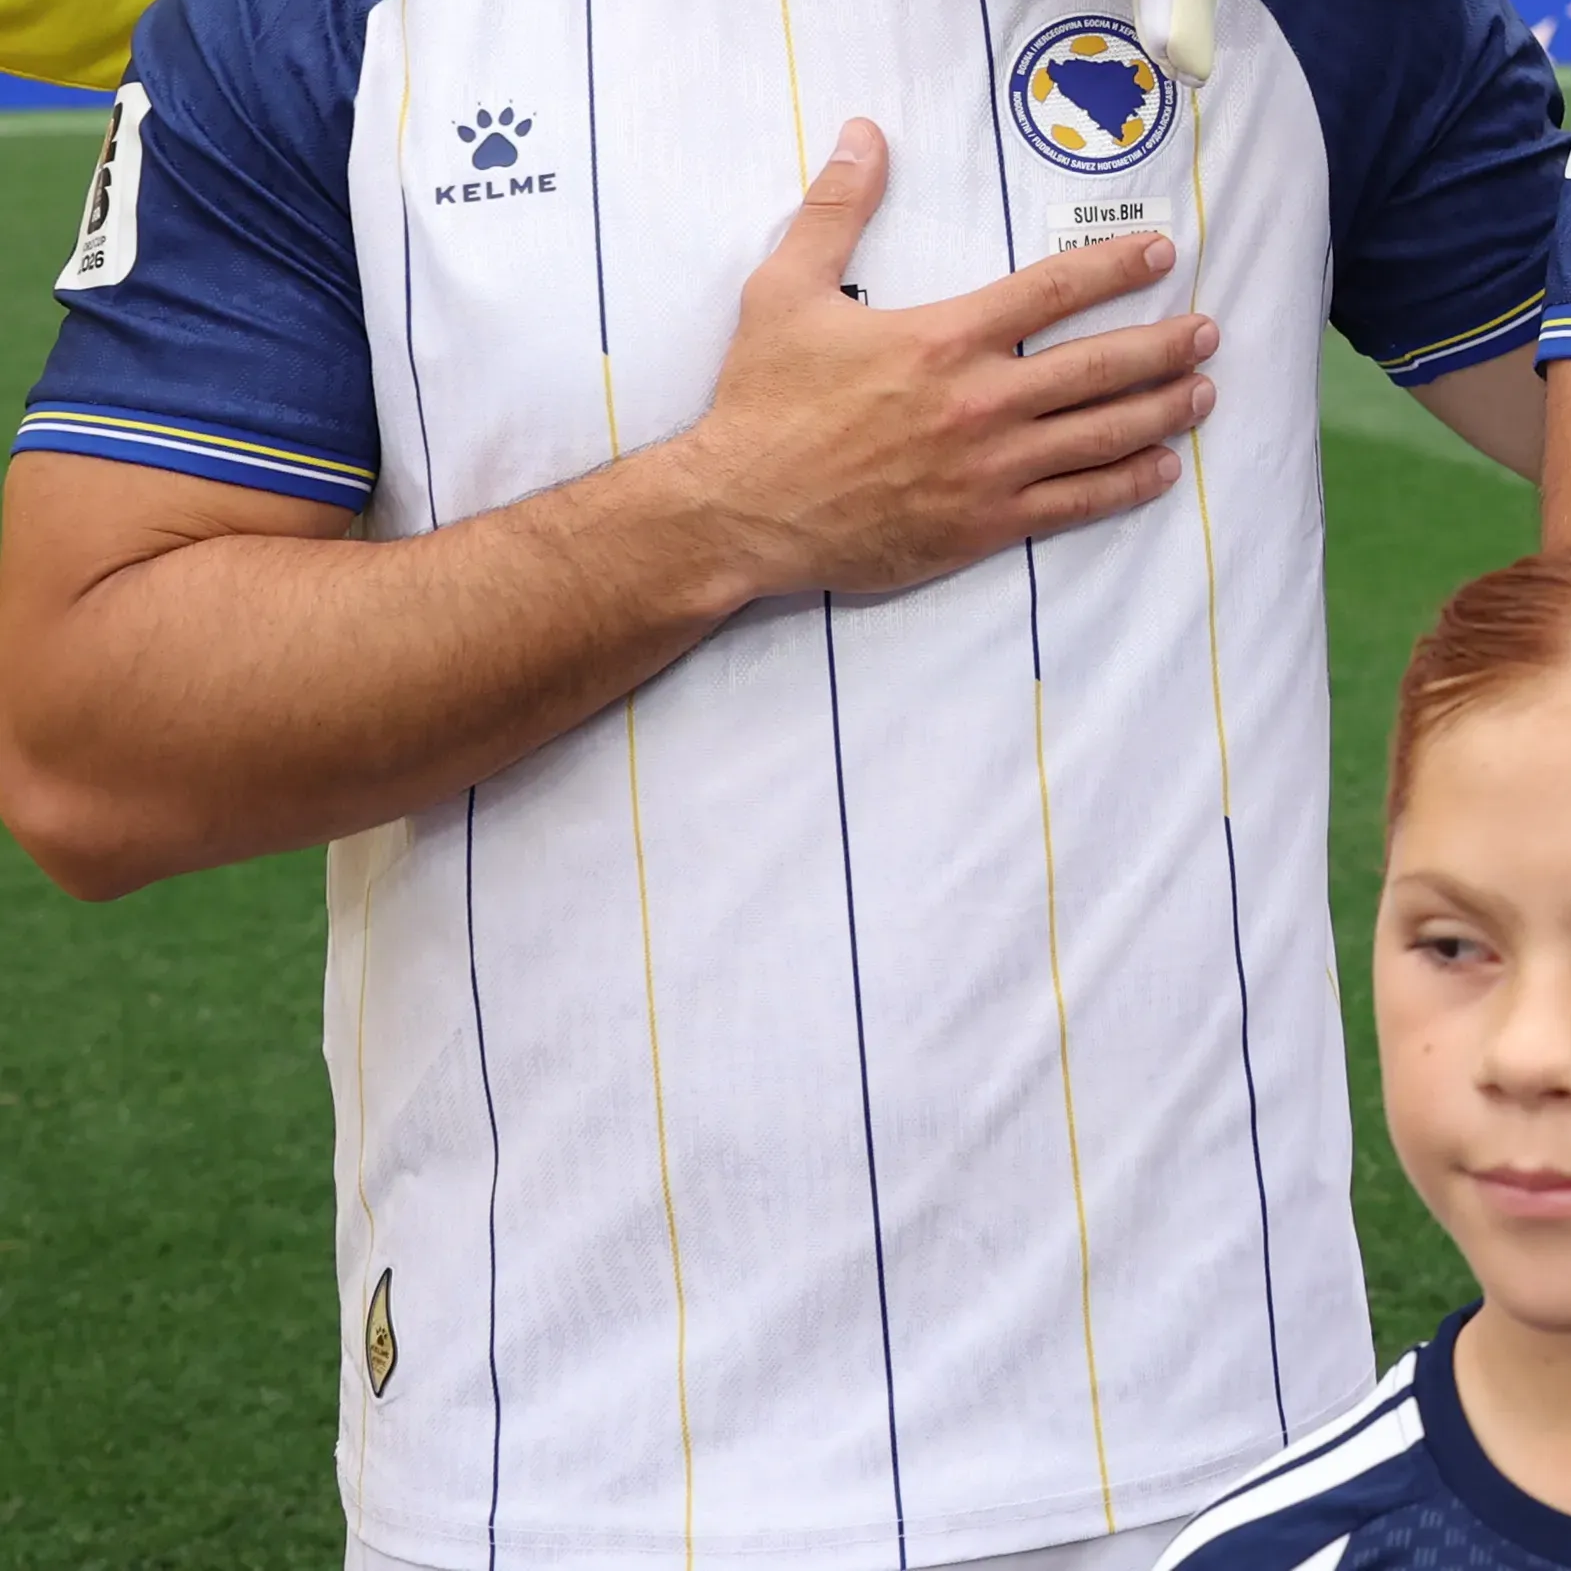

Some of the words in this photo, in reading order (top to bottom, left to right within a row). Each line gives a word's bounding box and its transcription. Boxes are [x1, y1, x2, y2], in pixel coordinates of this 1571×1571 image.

[1084, 19, 1111, 30] БОСНА
[1016, 52, 1033, 76] BOSNA
[1070, 160, 1097, 171] SAVEZ
[435, 173, 557, 206] KELME
[1074, 205, 1098, 223] SUI
[77, 250, 104, 275] 026
